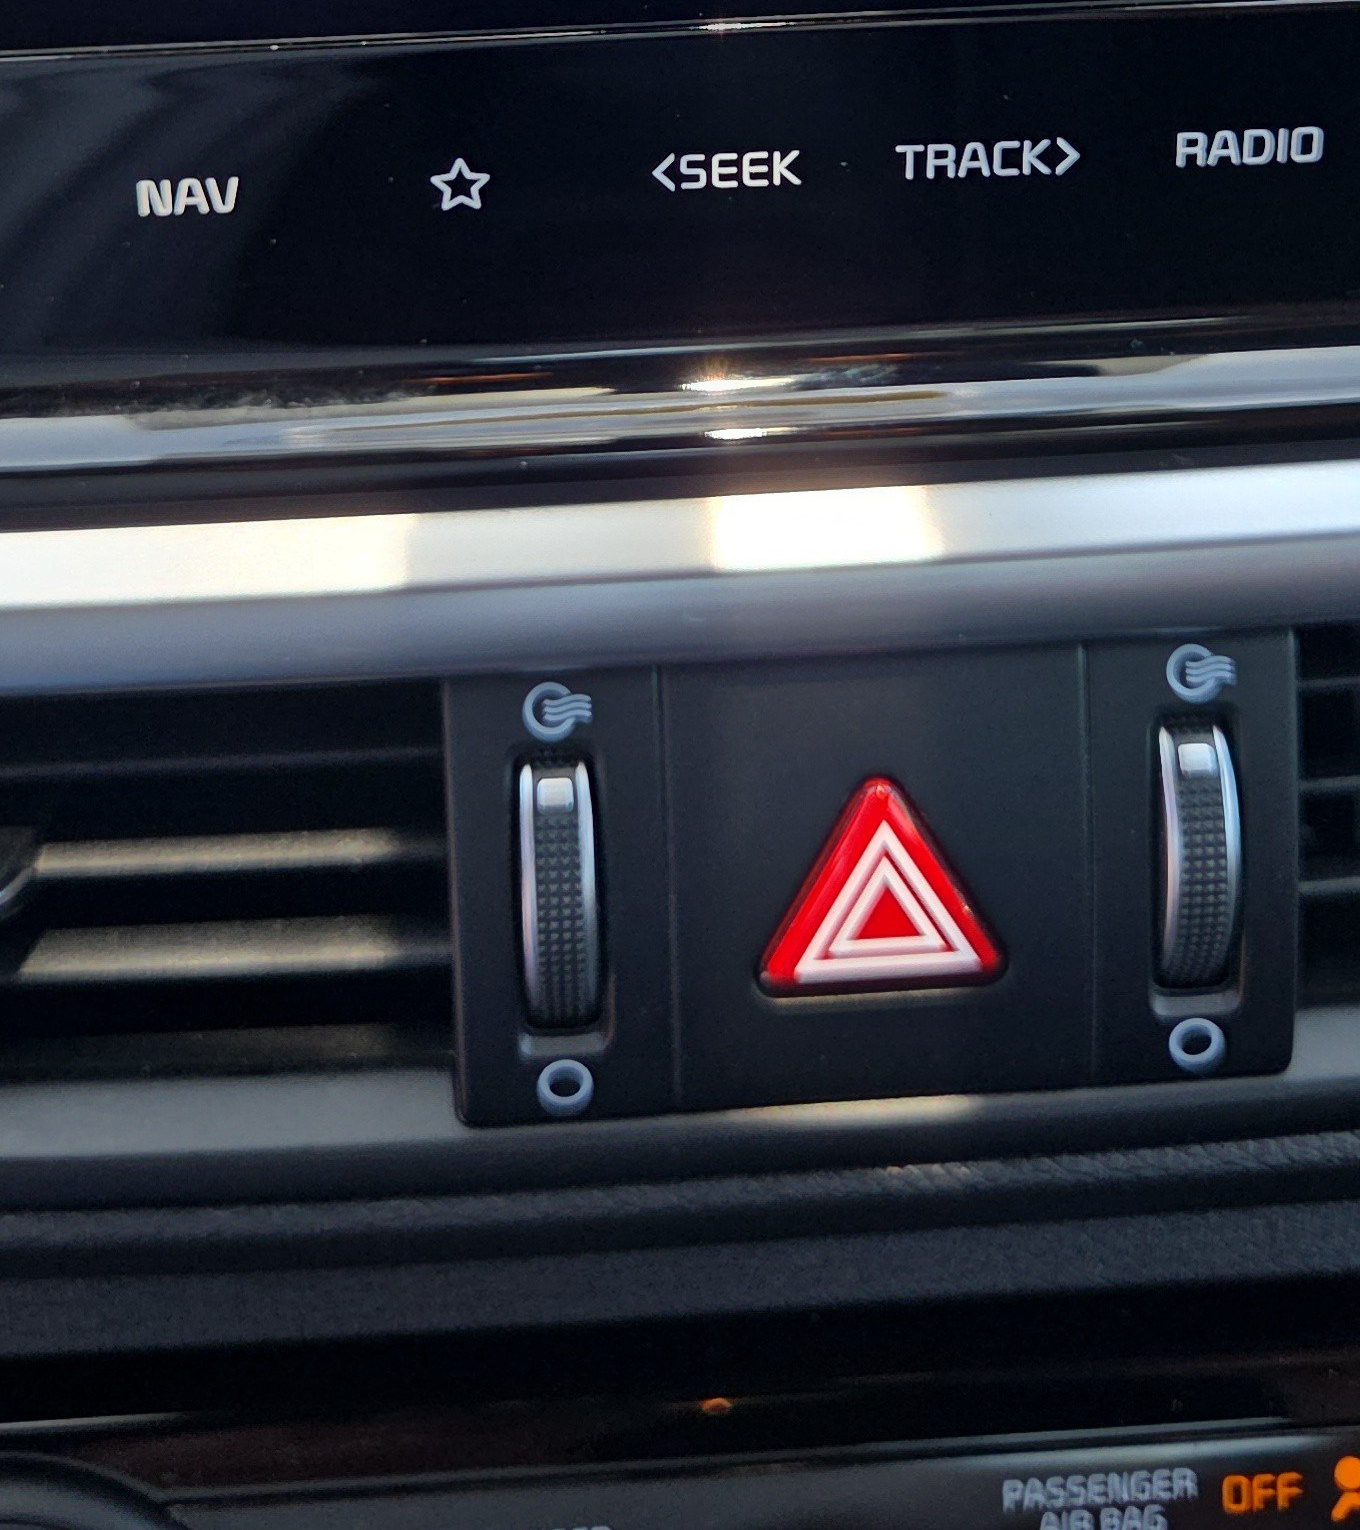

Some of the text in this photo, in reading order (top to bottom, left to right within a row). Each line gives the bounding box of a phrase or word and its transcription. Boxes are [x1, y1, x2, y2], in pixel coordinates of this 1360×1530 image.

[1174, 125, 1325, 169] RADIO
[134, 176, 240, 218] NAV
[1001, 1467, 1199, 1513] PASSENGER
[1221, 1471, 1304, 1516] OFF
